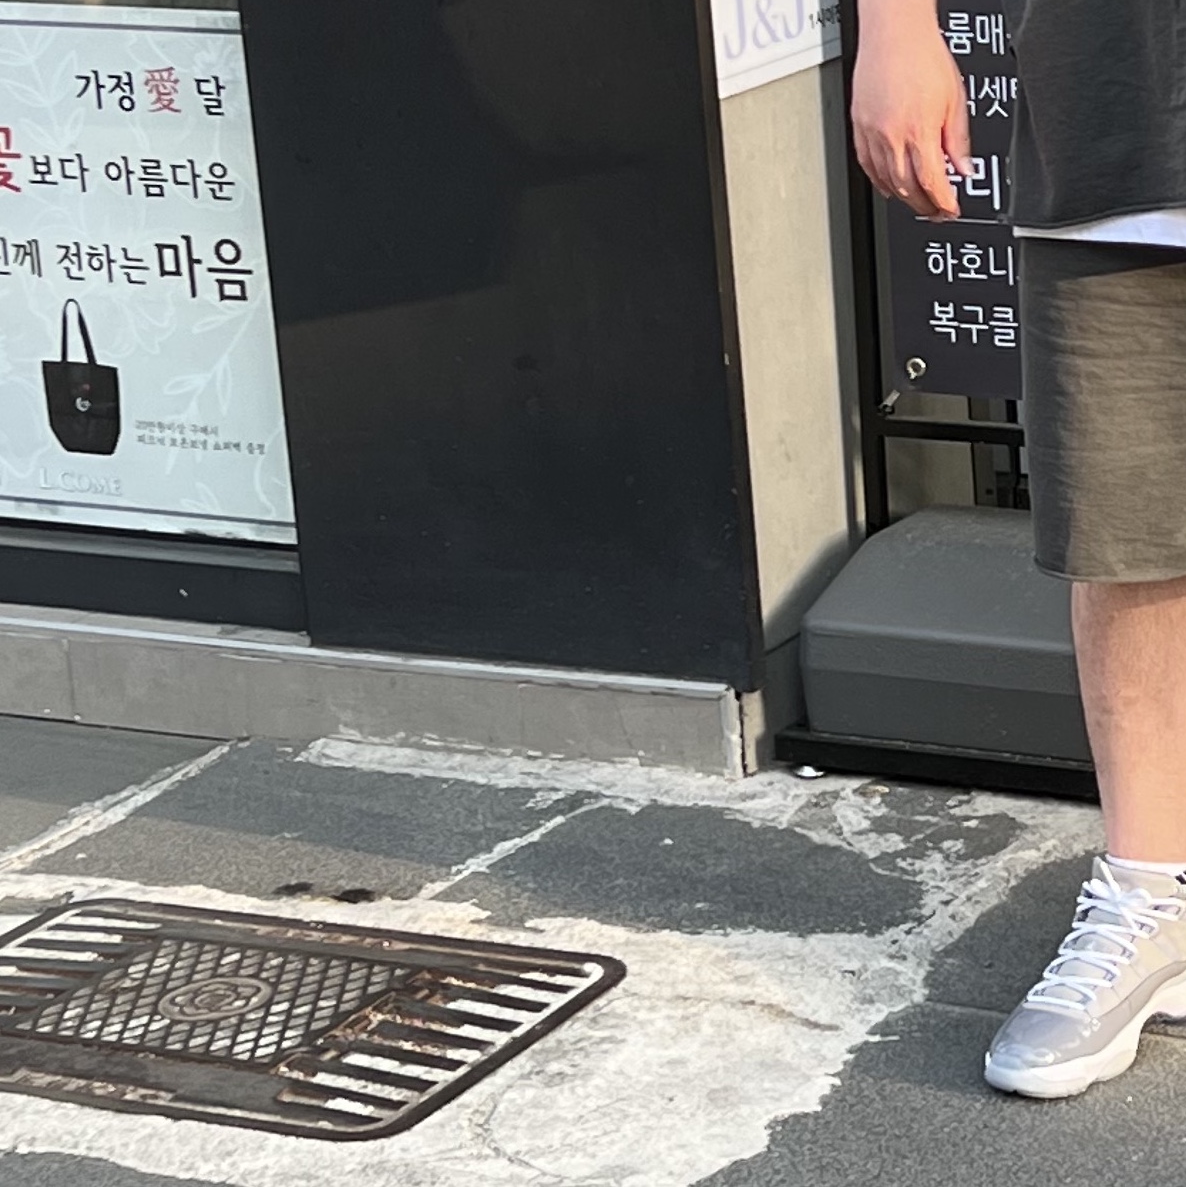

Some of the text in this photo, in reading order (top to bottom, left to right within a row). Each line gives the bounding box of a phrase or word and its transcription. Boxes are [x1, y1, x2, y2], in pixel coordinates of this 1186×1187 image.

[75, 66, 226, 117] 가정 愛 달
[104, 155, 236, 201] 아름다운
[56, 241, 150, 285] 전하는
[155, 234, 254, 302] 마음
[925, 241, 1020, 286] 하호니
[929, 301, 1019, 348] 복구클
